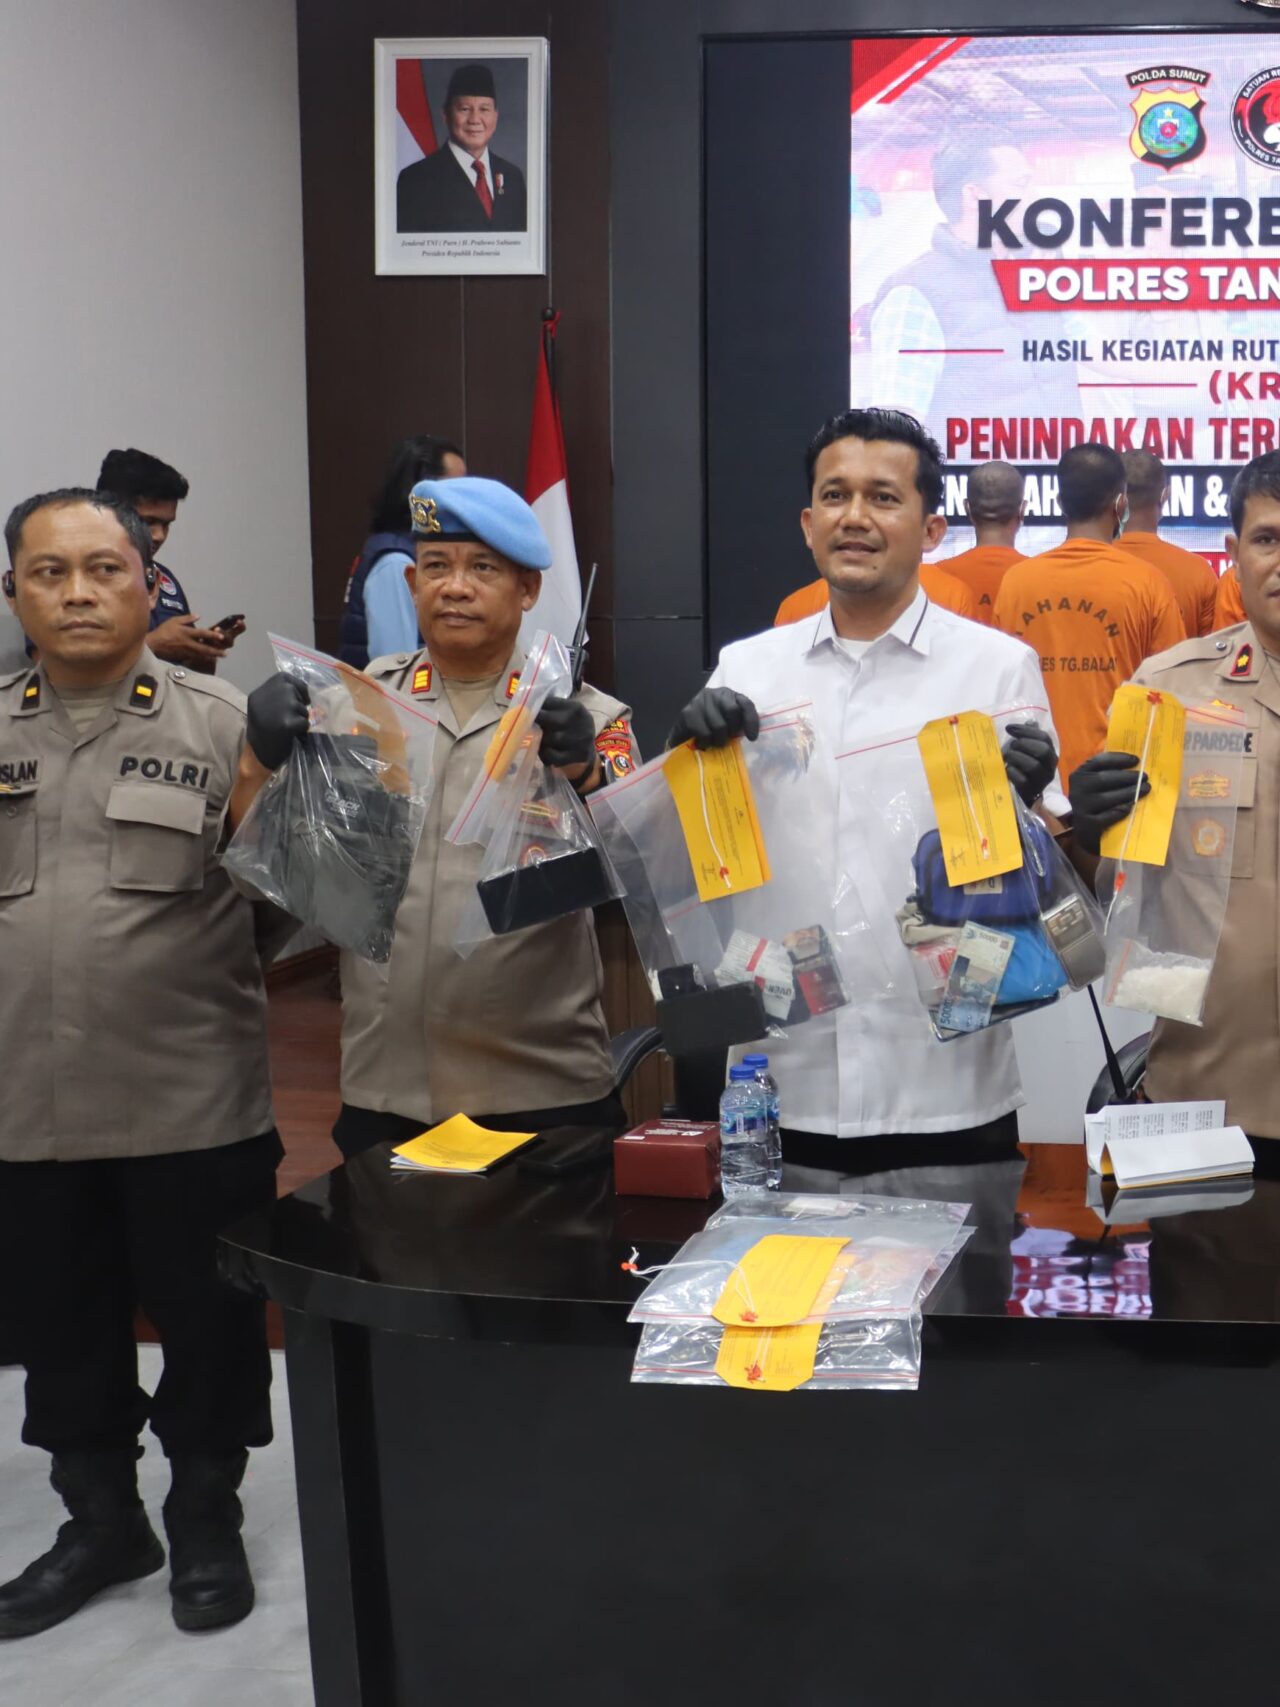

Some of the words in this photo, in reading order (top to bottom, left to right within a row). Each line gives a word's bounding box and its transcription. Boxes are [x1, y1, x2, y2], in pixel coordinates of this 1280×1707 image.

[1130, 69, 1167, 85] POLDA
[1168, 69, 1206, 84] SUMUT
[1242, 73, 1270, 98] SATUAN
[1244, 138, 1271, 162] POLRES
[1018, 266, 1189, 302] POLRES
[1022, 339, 1094, 362] HASIL
[1102, 339, 1223, 362] KEGIATAN
[946, 417, 1194, 461] PENINDAKAN
[1203, 475, 1229, 518] &
[1016, 597, 1120, 639] AHANAN
[119, 756, 209, 789] POLRI
